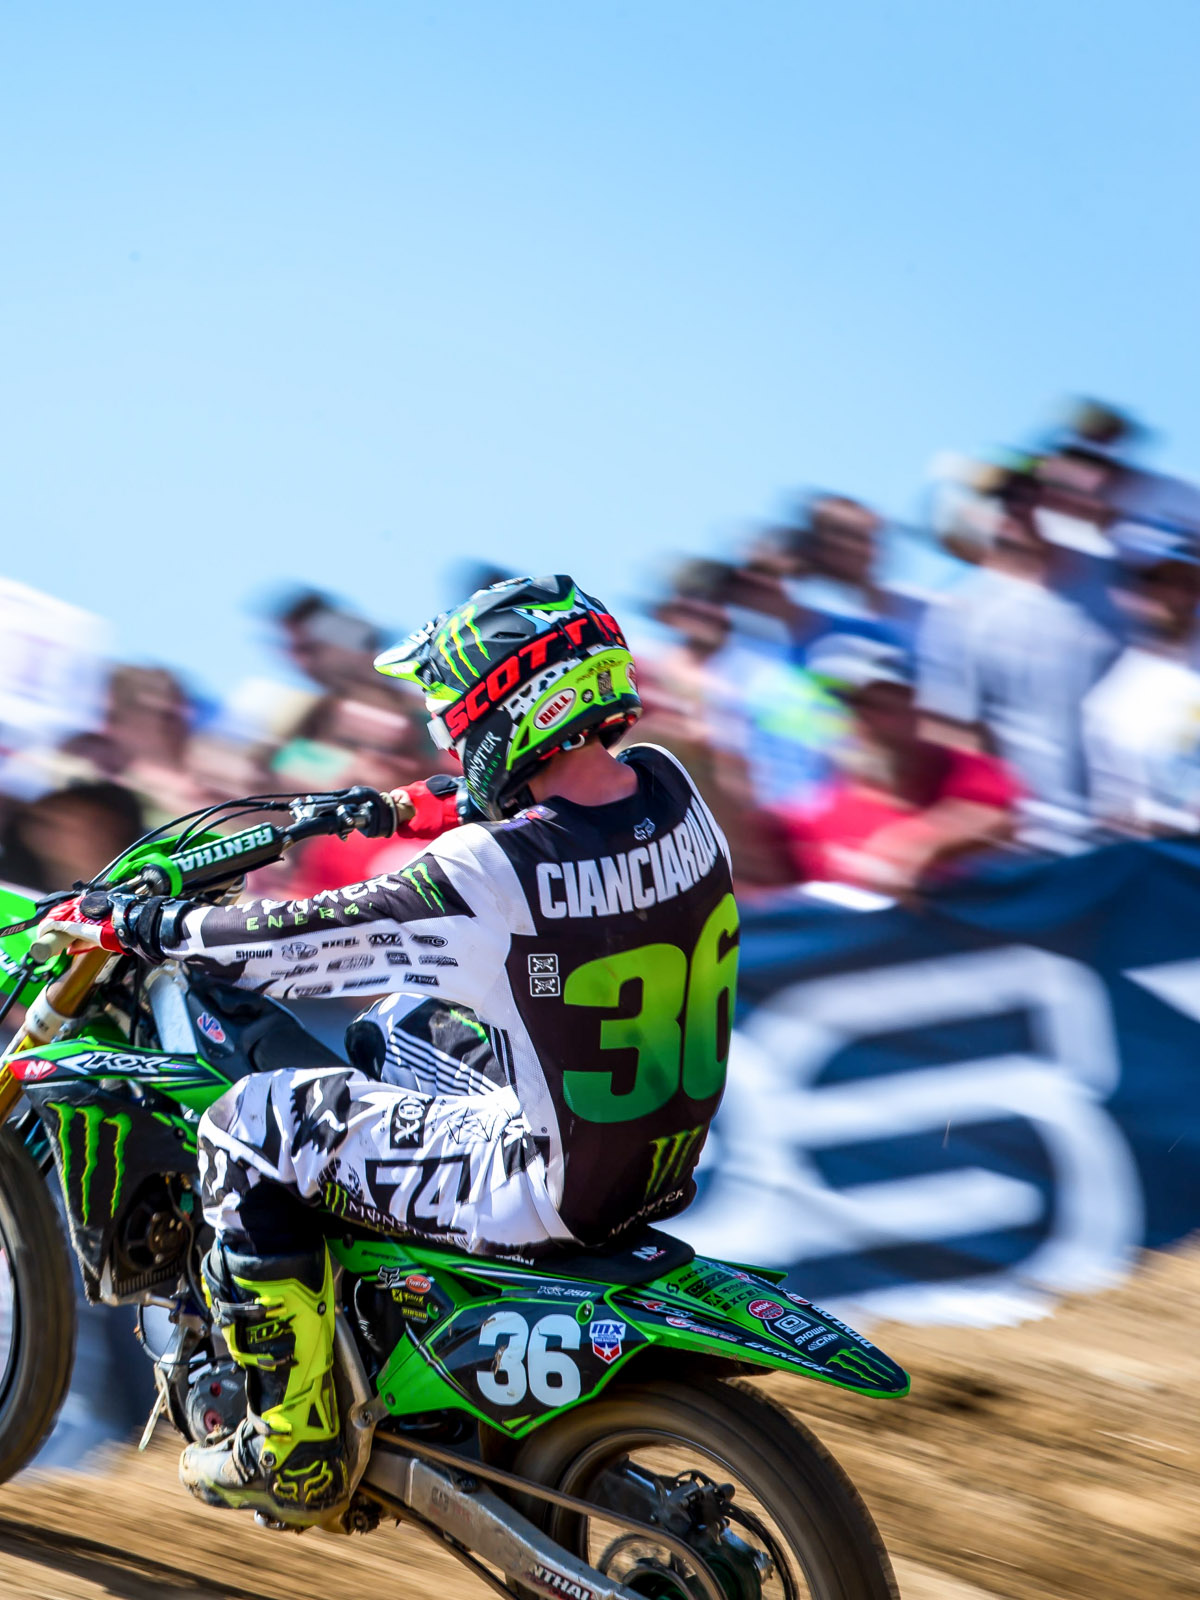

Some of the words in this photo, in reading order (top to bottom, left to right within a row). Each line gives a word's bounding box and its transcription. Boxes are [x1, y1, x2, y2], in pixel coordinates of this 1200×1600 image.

[445, 618, 588, 740] SCOTT
[538, 695, 571, 725] BELL
[246, 902, 373, 931] ENERG
[563, 893, 739, 1123] 36
[367, 1155, 469, 1230] 74
[350, 1201, 467, 1250] MONS
[753, 1302, 772, 1313] NGK
[592, 1323, 624, 1335] MX
[794, 1326, 827, 1346] SHOWA
[476, 1311, 581, 1407] 36
[744, 1341, 834, 1373] DUNLOP
